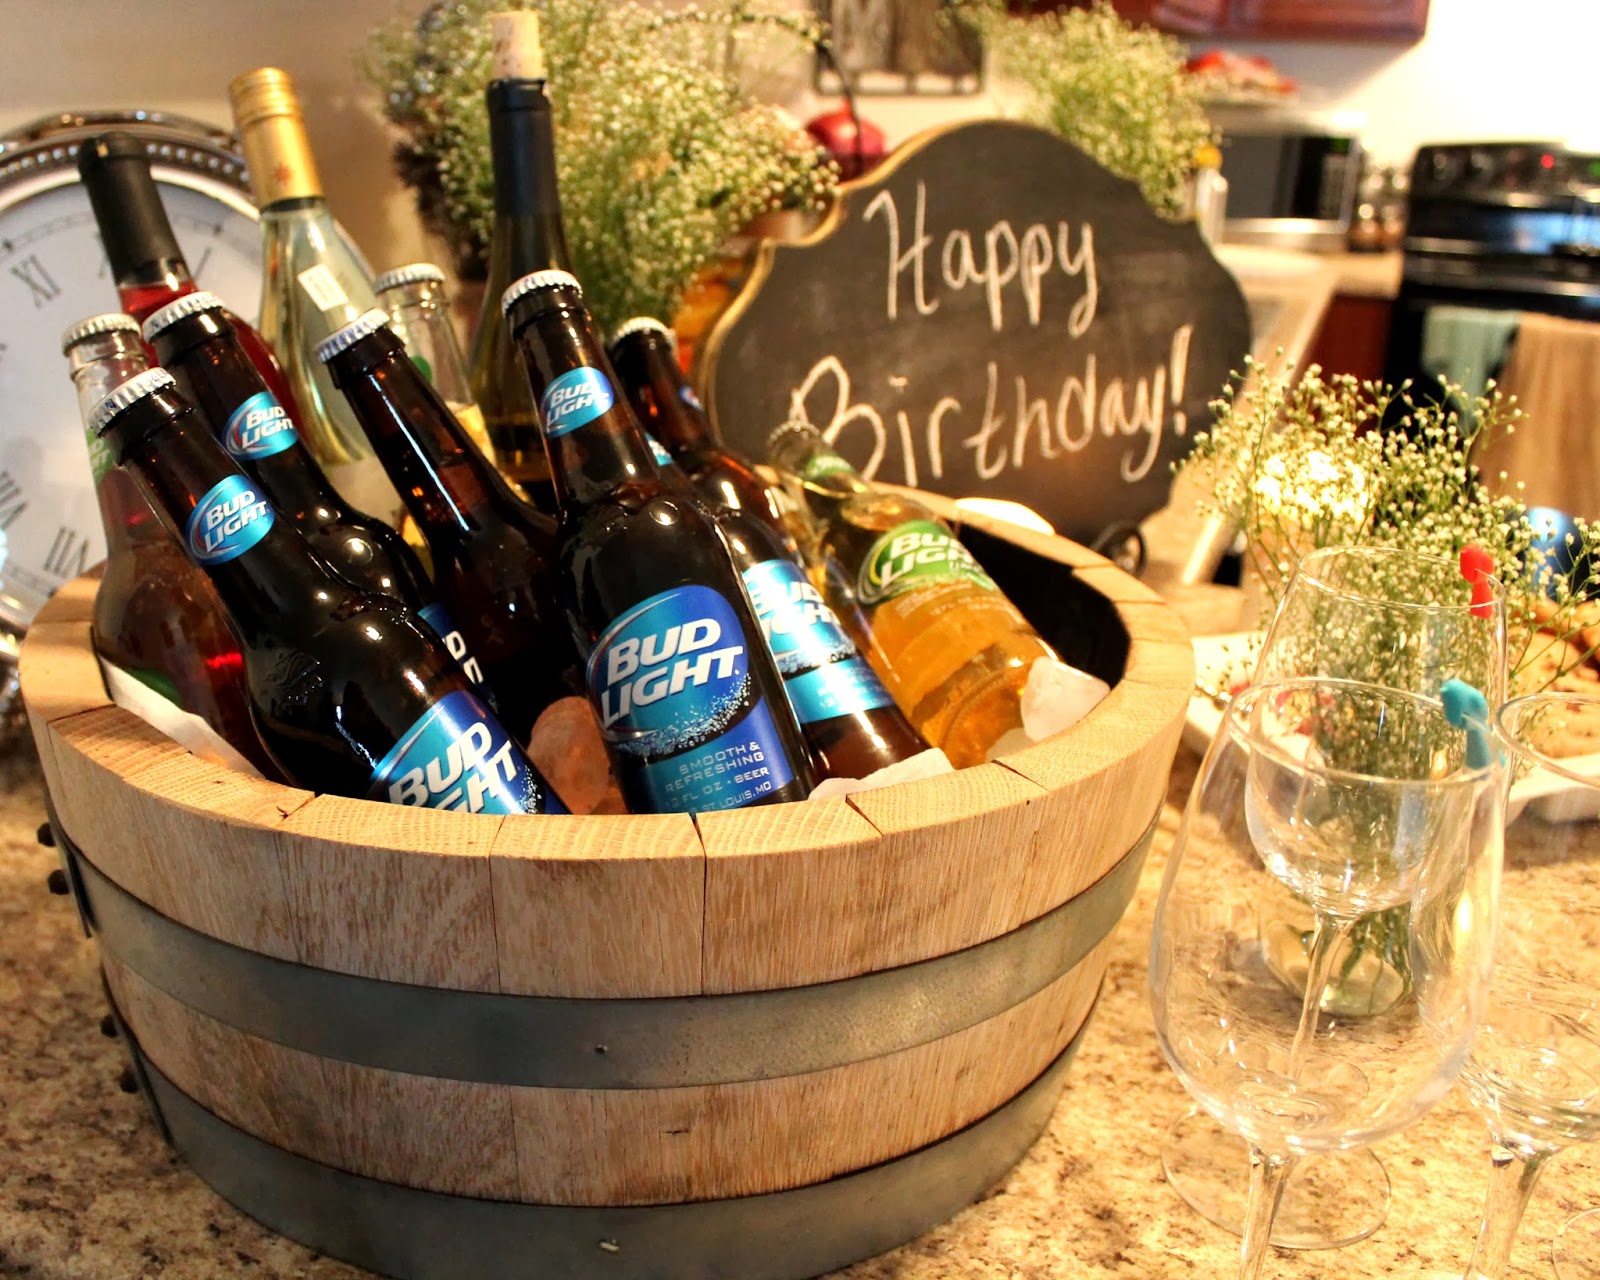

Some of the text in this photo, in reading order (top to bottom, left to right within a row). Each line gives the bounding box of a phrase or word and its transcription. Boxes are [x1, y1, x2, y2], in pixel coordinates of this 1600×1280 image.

[862, 179, 1098, 339] Happy
[551, 380, 599, 408] BUD
[788, 323, 1194, 488] Birthday!
[241, 417, 294, 449] LIGHT
[246, 405, 287, 431] BUD
[204, 500, 267, 553] LIGHT
[205, 490, 256, 531] BUD
[881, 547, 975, 589] LIGH
[607, 618, 722, 686] BUD
[601, 645, 744, 728] LIGHT
[388, 721, 493, 808] BUD
[664, 751, 765, 793] REFRESHING
[679, 741, 760, 775] SMOOTH &
[734, 767, 769, 784] BEER
[756, 781, 772, 795] MO
